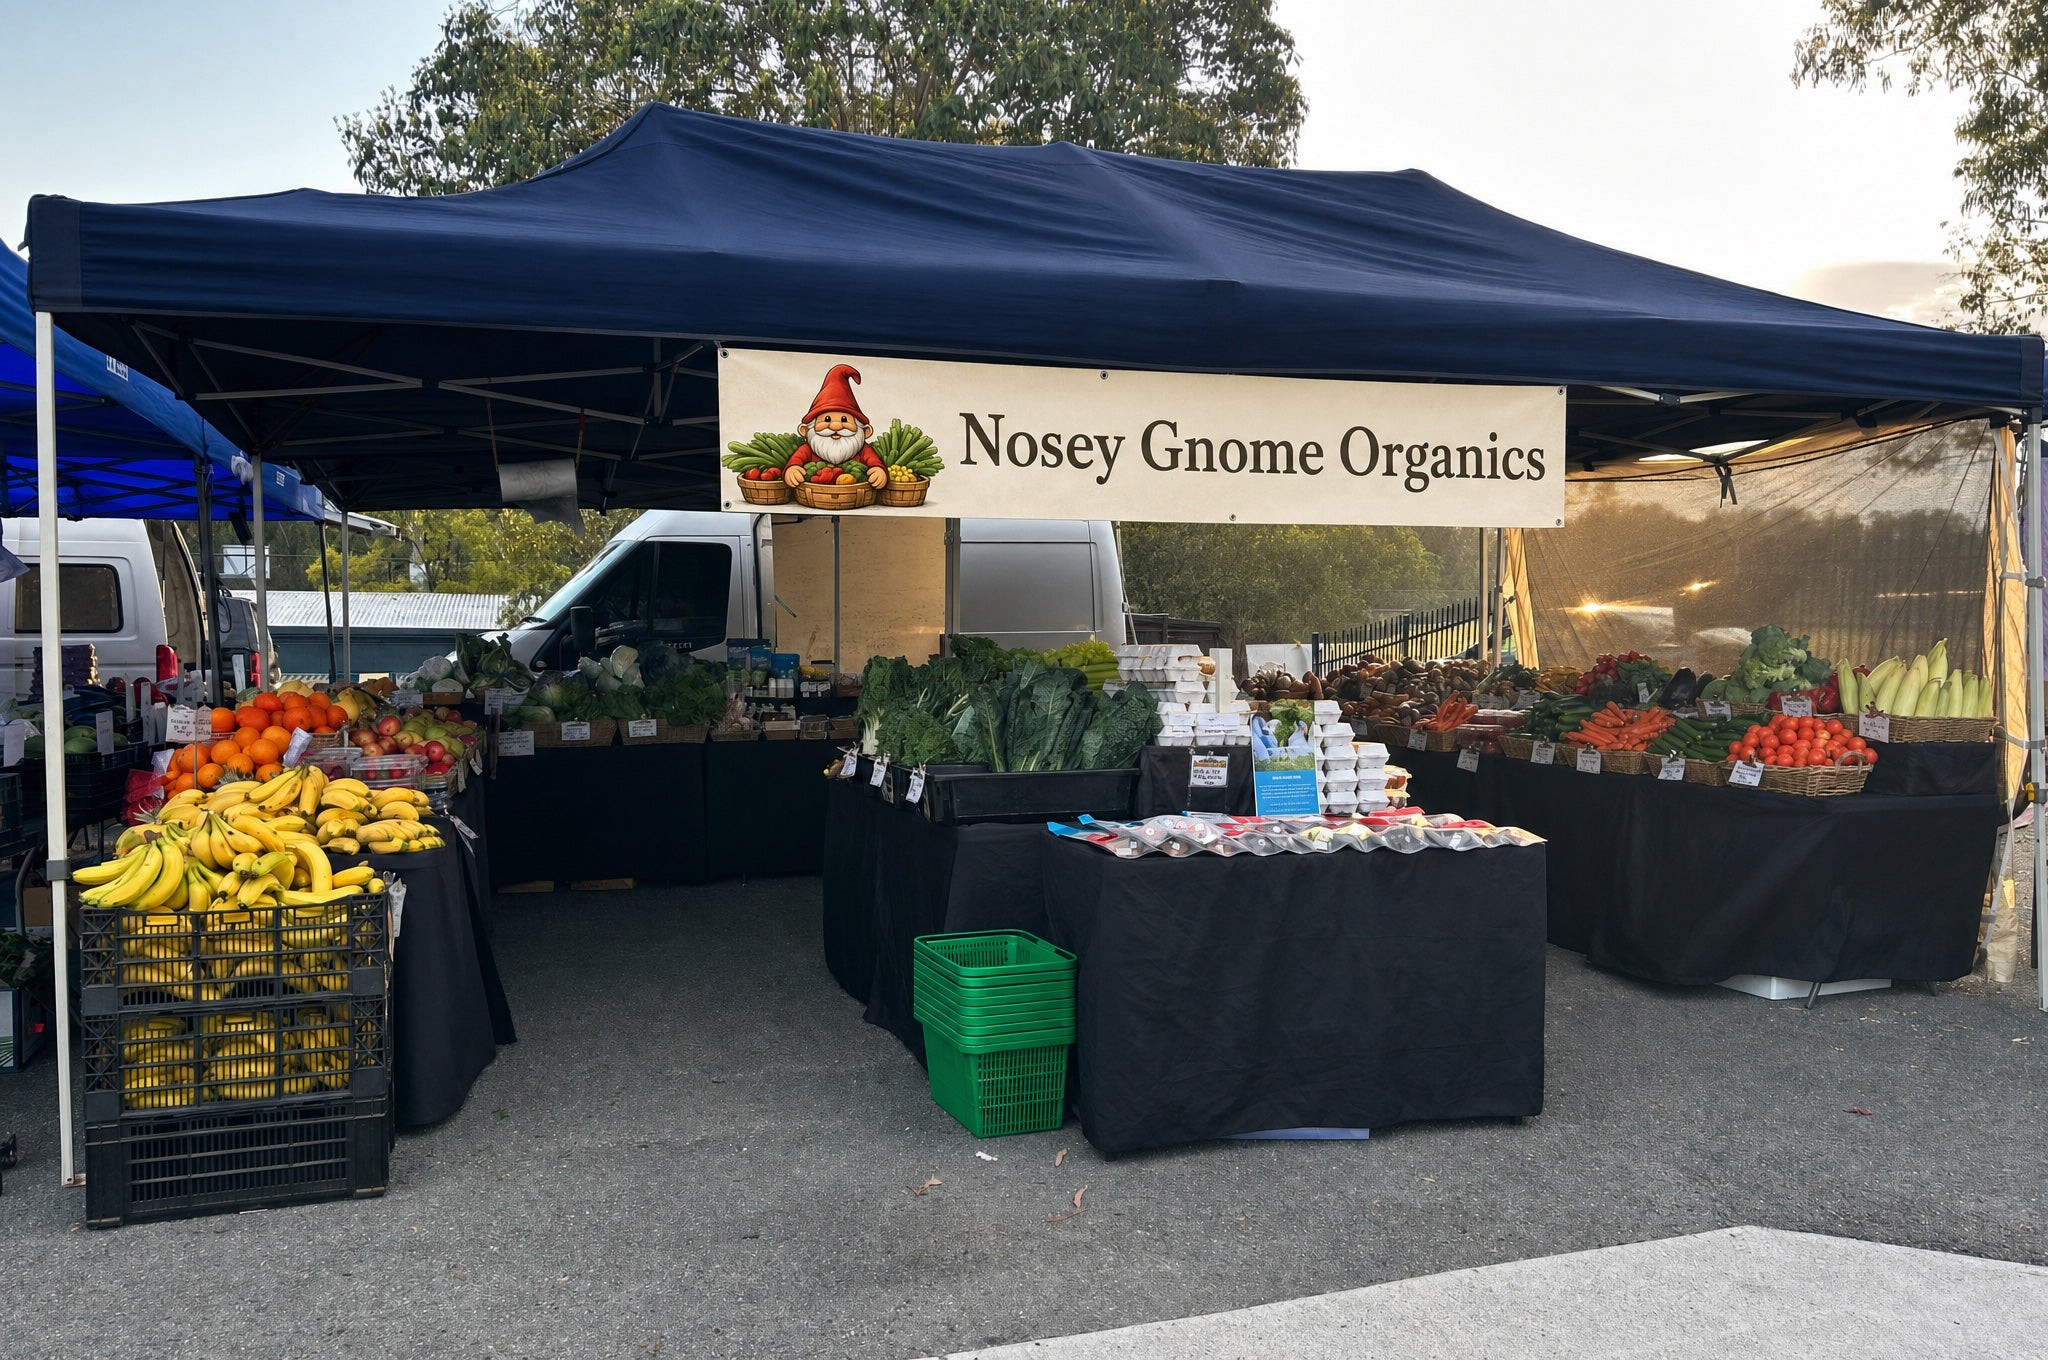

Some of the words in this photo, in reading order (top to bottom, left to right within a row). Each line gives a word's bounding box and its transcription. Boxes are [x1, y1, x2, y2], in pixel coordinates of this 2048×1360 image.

[959, 412, 1126, 485] Nosey
[1141, 419, 1324, 477] Gnome
[1340, 425, 1546, 493] Organics
